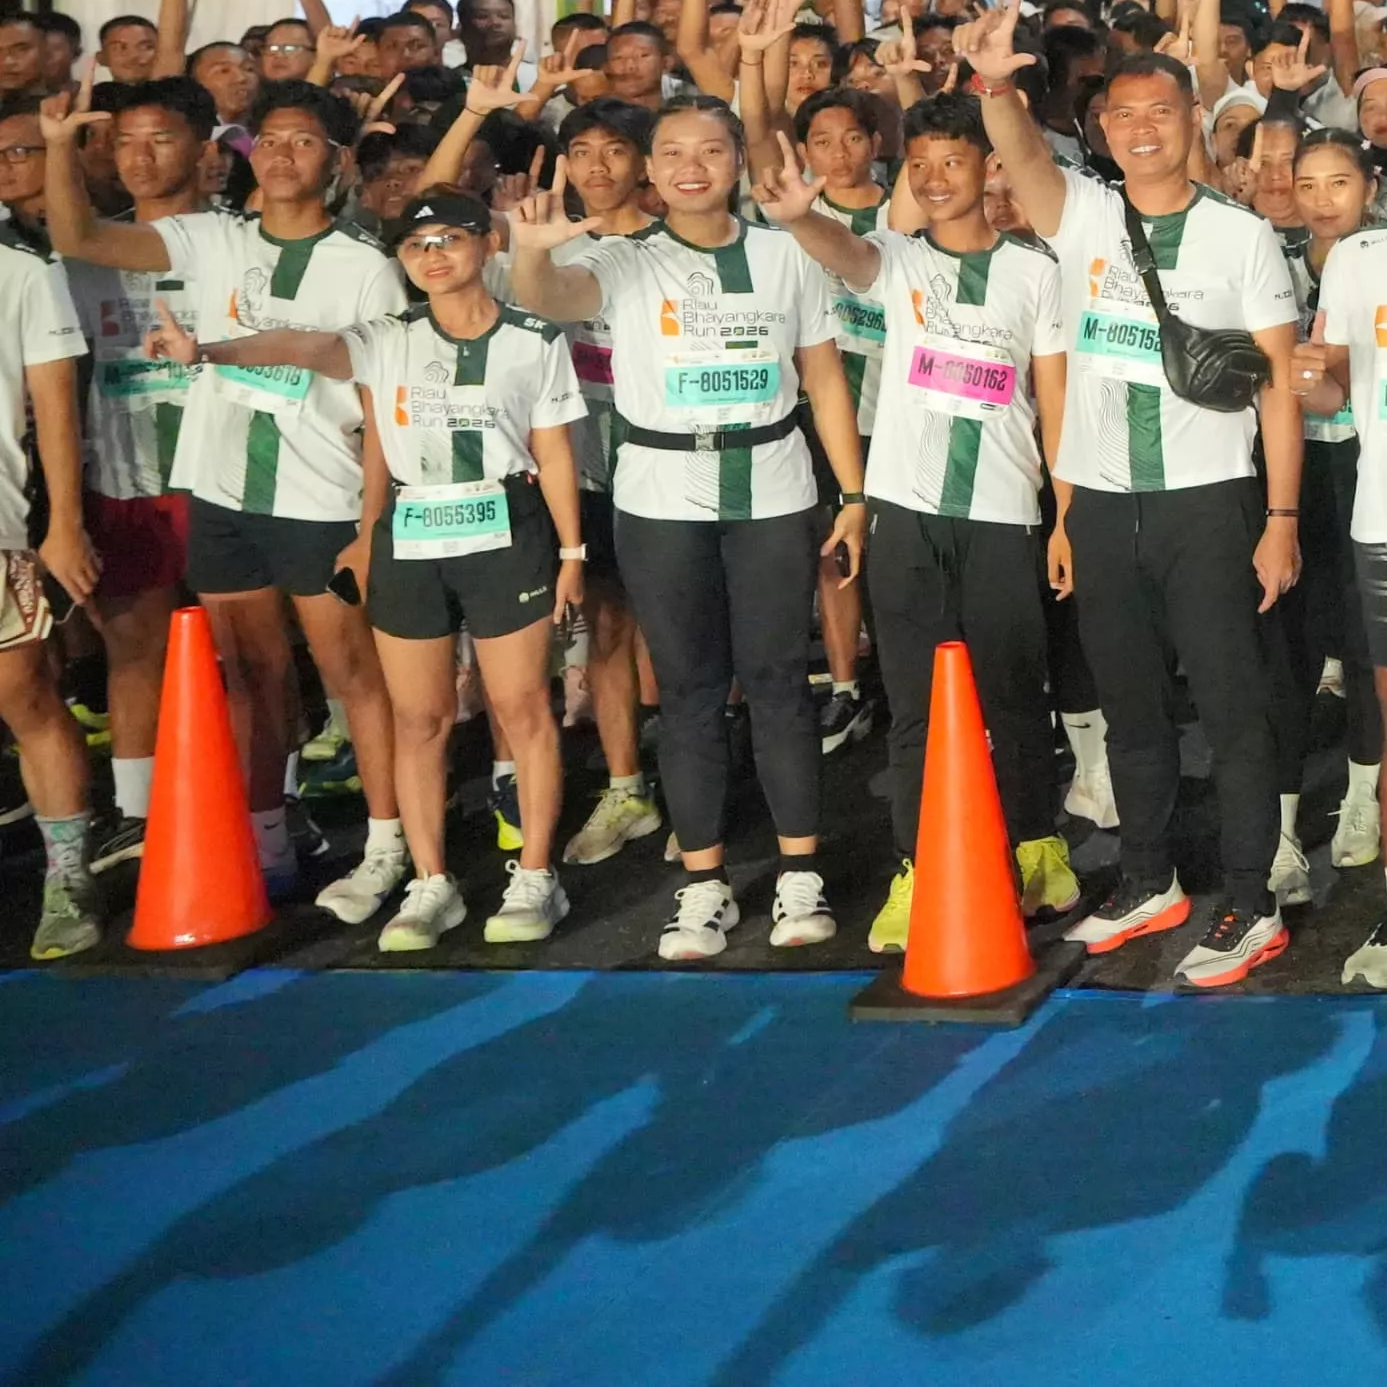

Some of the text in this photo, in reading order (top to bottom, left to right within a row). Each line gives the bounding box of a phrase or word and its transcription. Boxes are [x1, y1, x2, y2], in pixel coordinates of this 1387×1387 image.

[682, 298, 718, 312] Riau
[682, 311, 786, 325] Bhayangkara
[683, 324, 769, 337] Run 2026
[677, 368, 770, 394] F-8051529
[411, 386, 447, 401] Riau
[412, 416, 497, 429] Run 2026
